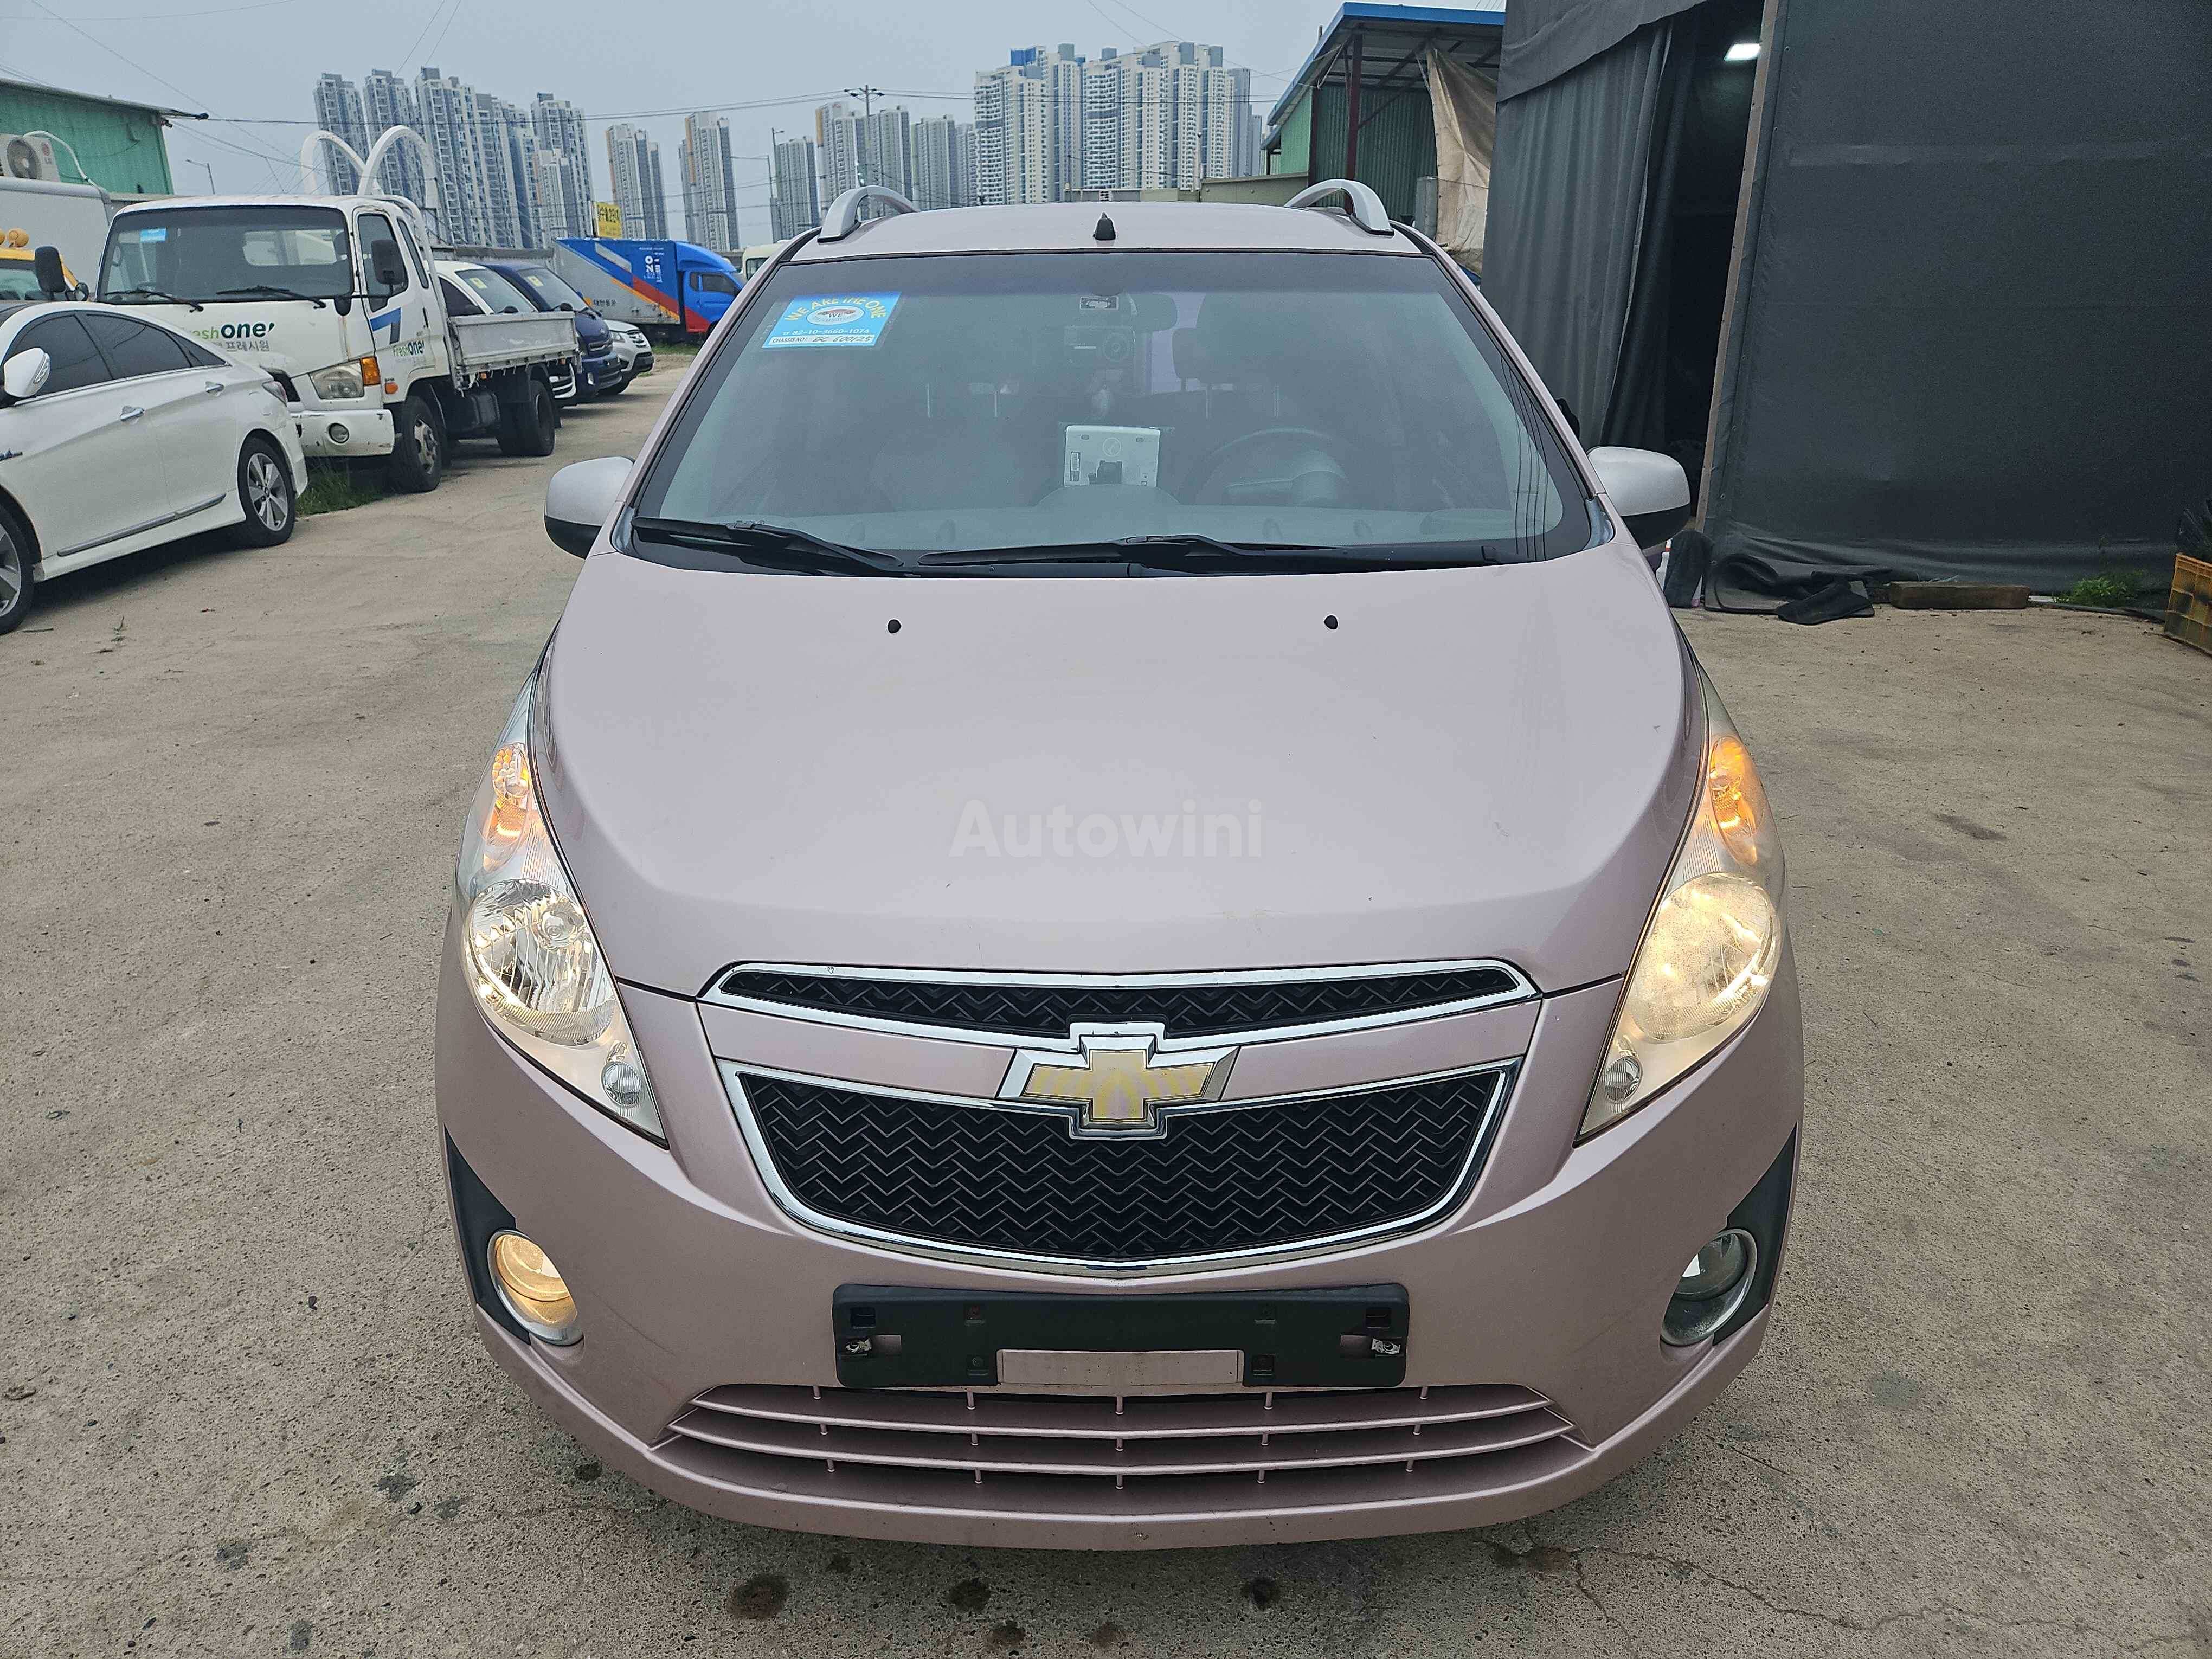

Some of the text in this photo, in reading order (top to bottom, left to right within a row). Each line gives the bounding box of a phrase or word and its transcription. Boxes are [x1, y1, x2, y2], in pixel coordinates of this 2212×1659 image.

[785, 307, 809, 321] WE
[812, 298, 839, 310] ARE
[865, 300, 886, 319] ONE
[226, 340, 270, 352] 프레시원
